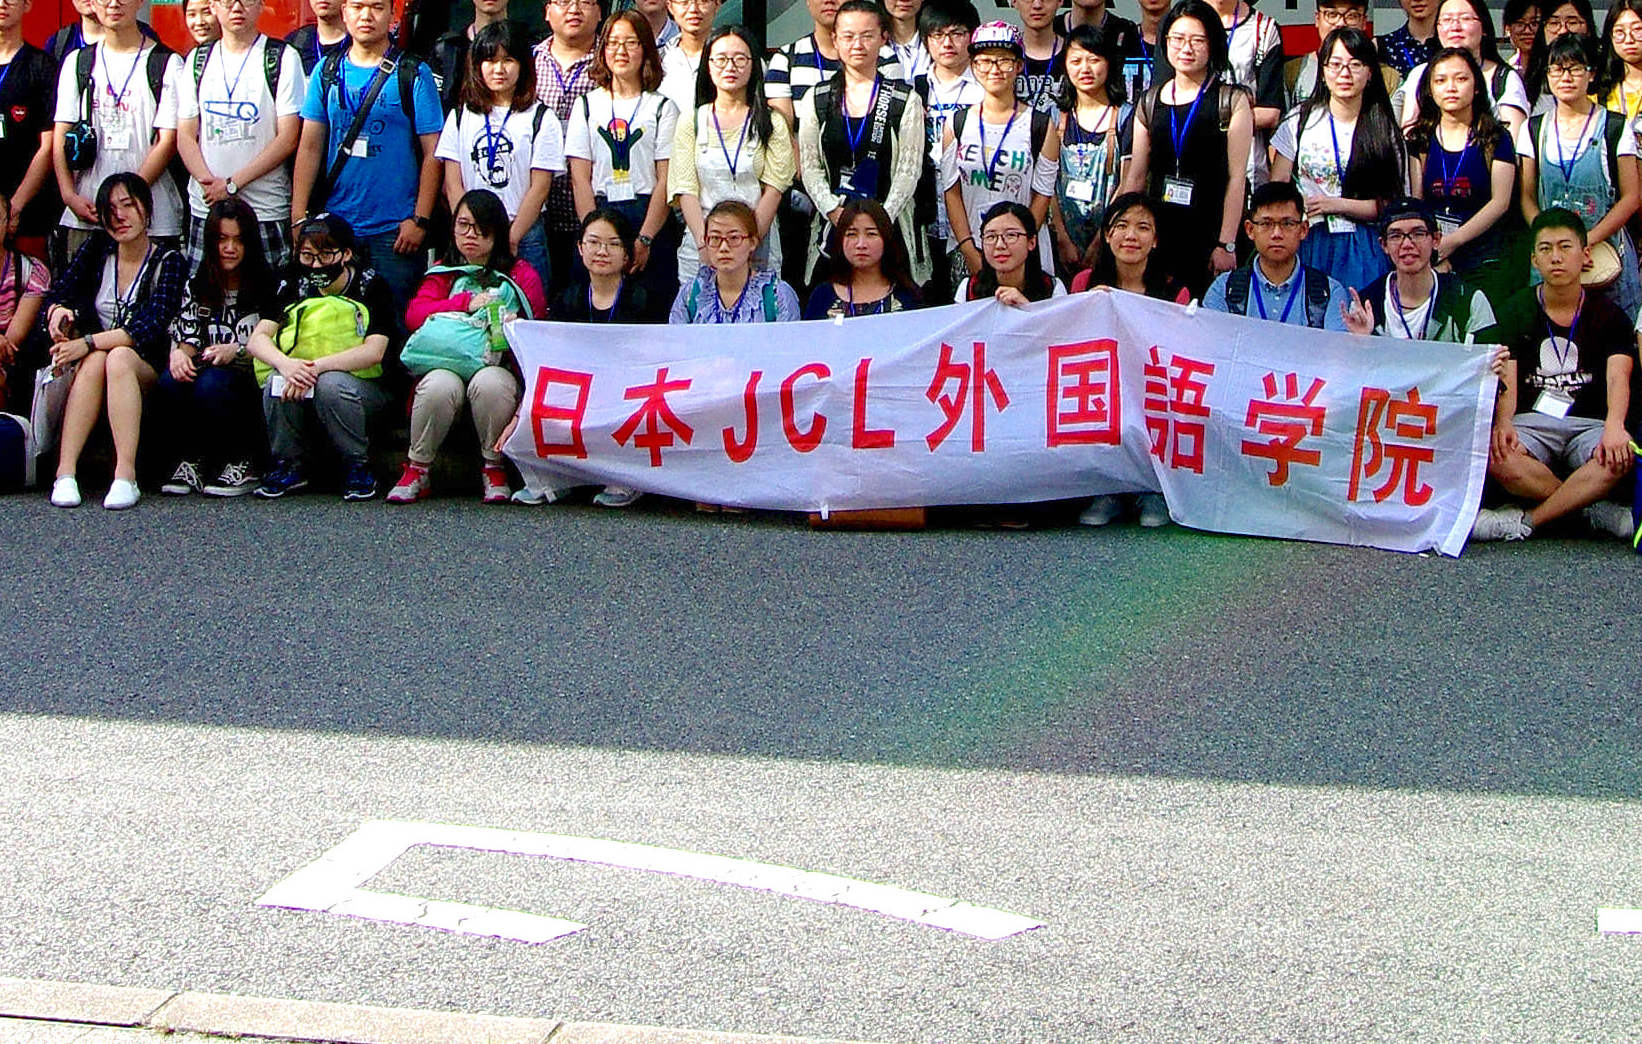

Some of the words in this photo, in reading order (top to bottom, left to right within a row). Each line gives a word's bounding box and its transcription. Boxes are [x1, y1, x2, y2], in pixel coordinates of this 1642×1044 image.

[531, 338, 1439, 506] 日本JCL外国語学院
